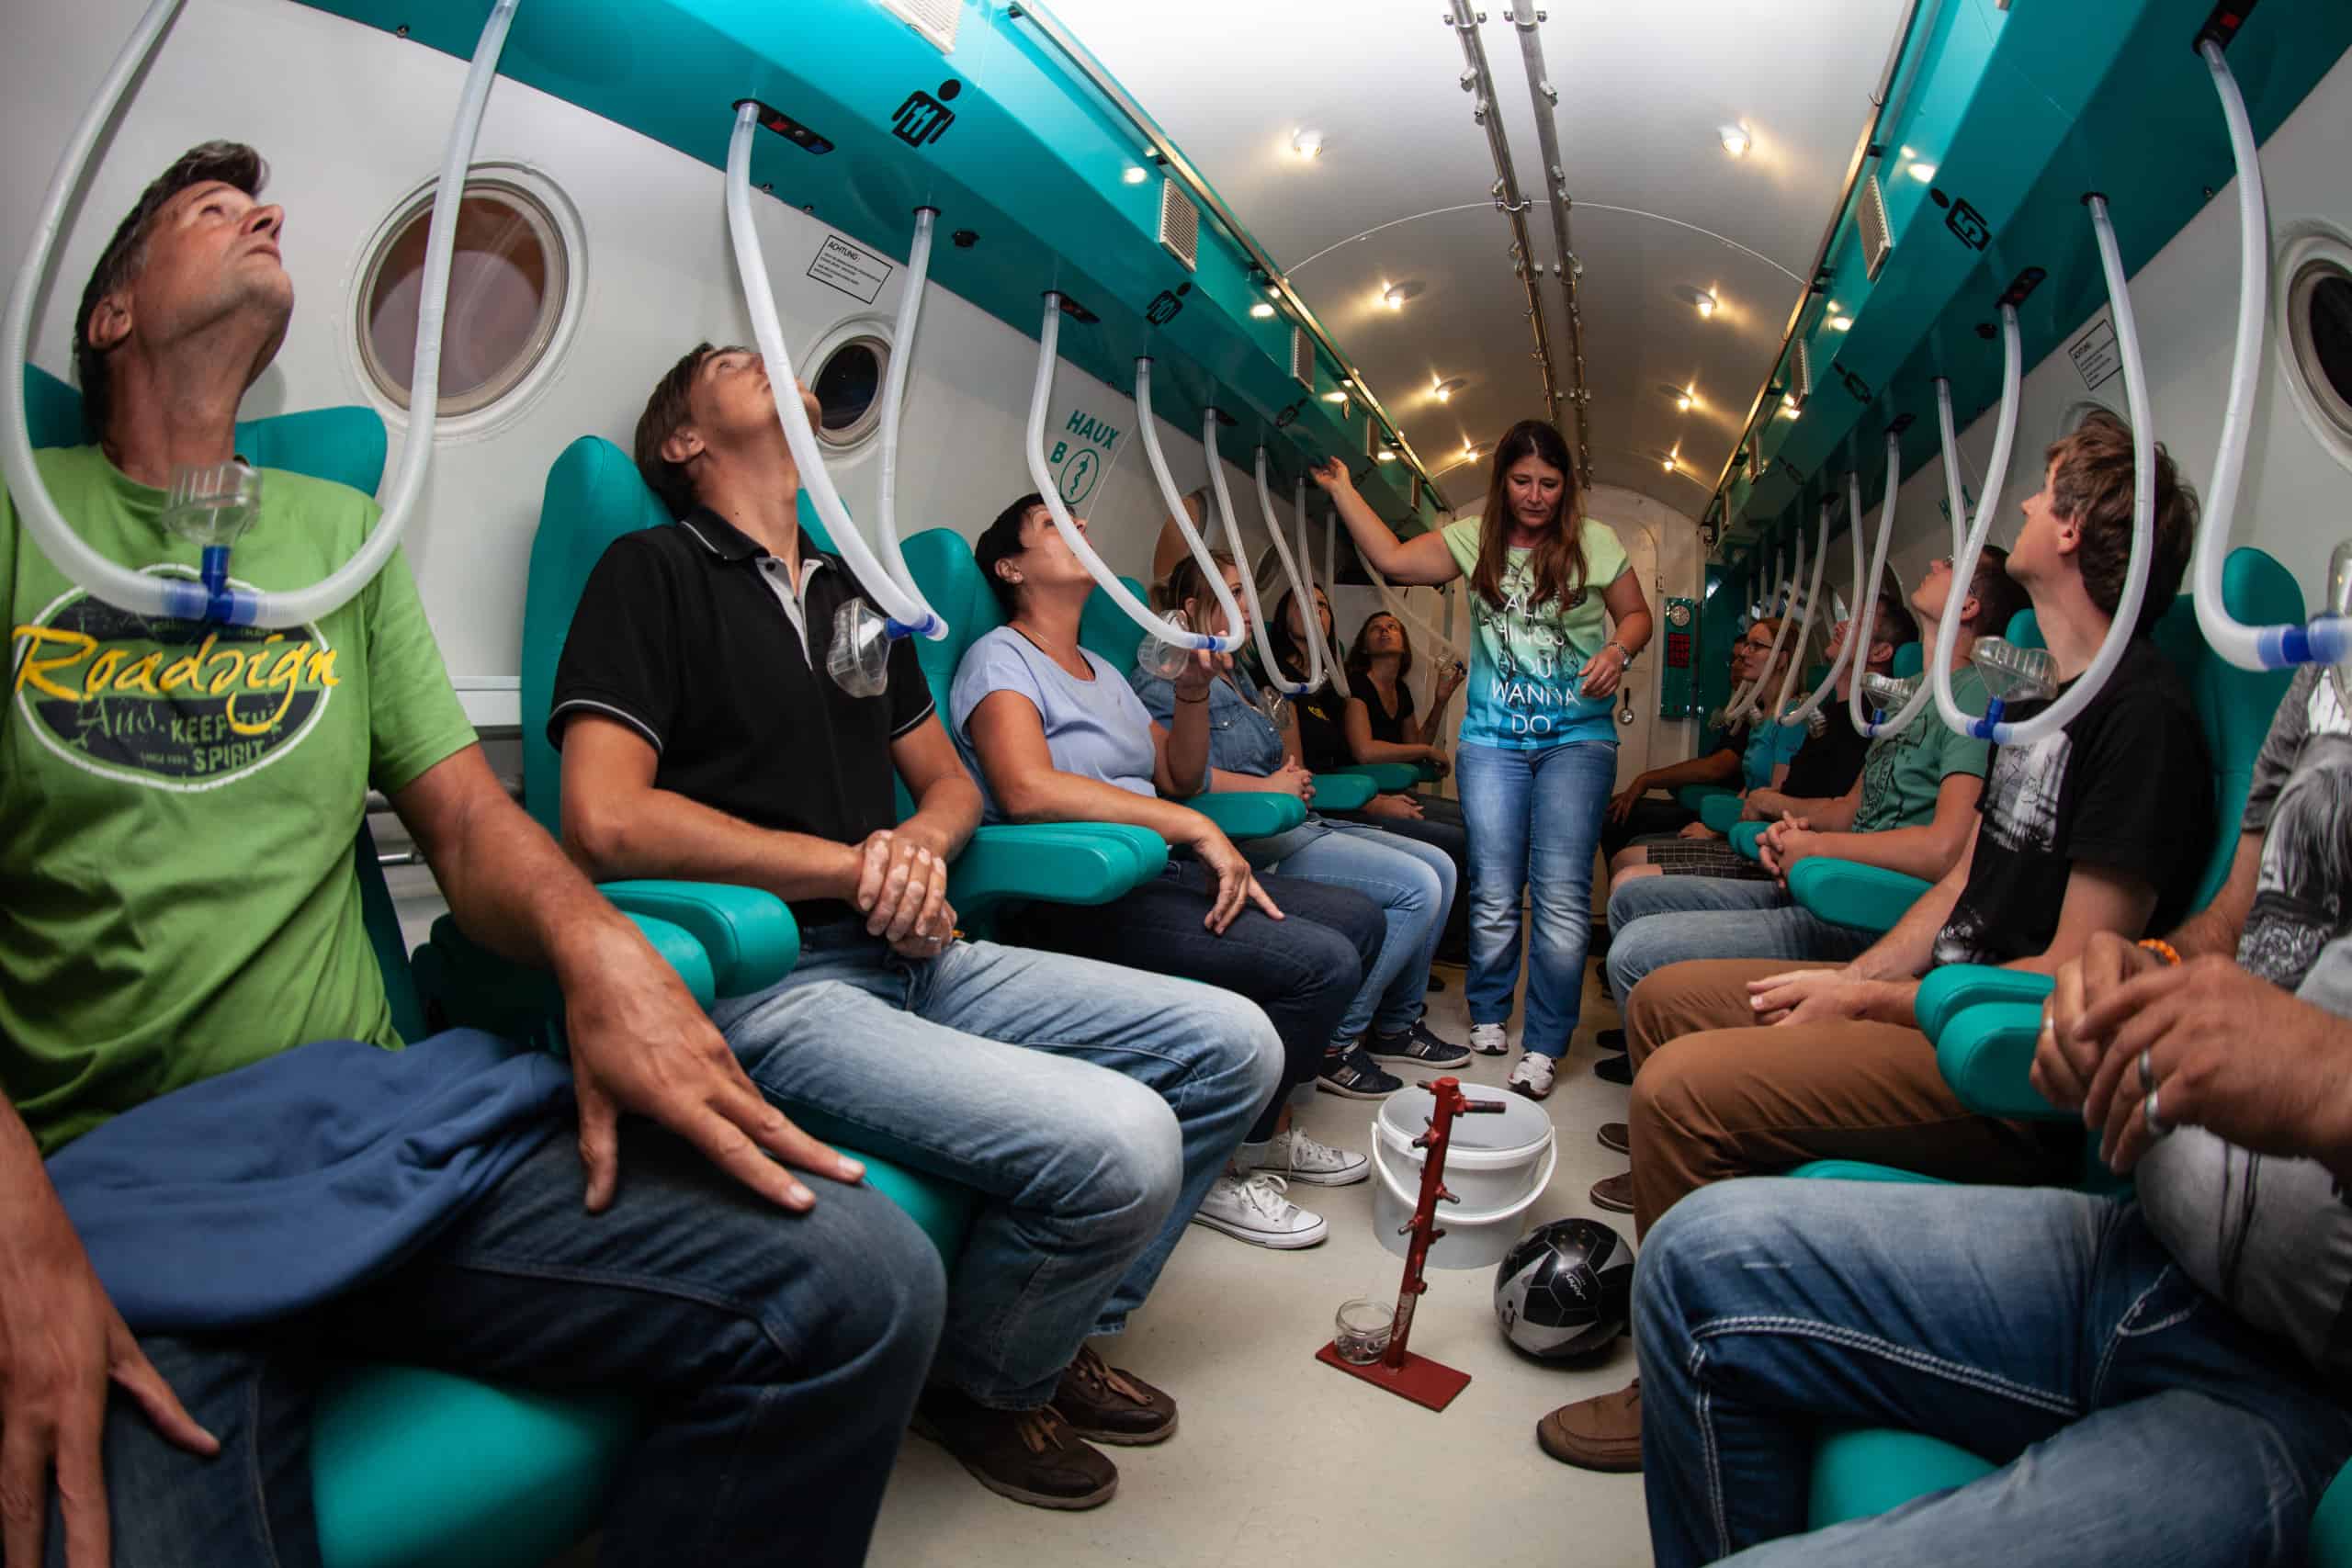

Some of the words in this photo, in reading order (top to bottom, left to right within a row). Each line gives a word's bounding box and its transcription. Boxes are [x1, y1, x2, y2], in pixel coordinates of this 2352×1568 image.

[1066, 410, 1120, 450] HAUX
[1050, 441, 1068, 464] B
[1491, 678, 1581, 706] WANNA
[171, 714, 229, 743] KEEP
[1511, 714, 1552, 734] DO
[192, 739, 266, 772] SPIRIT
